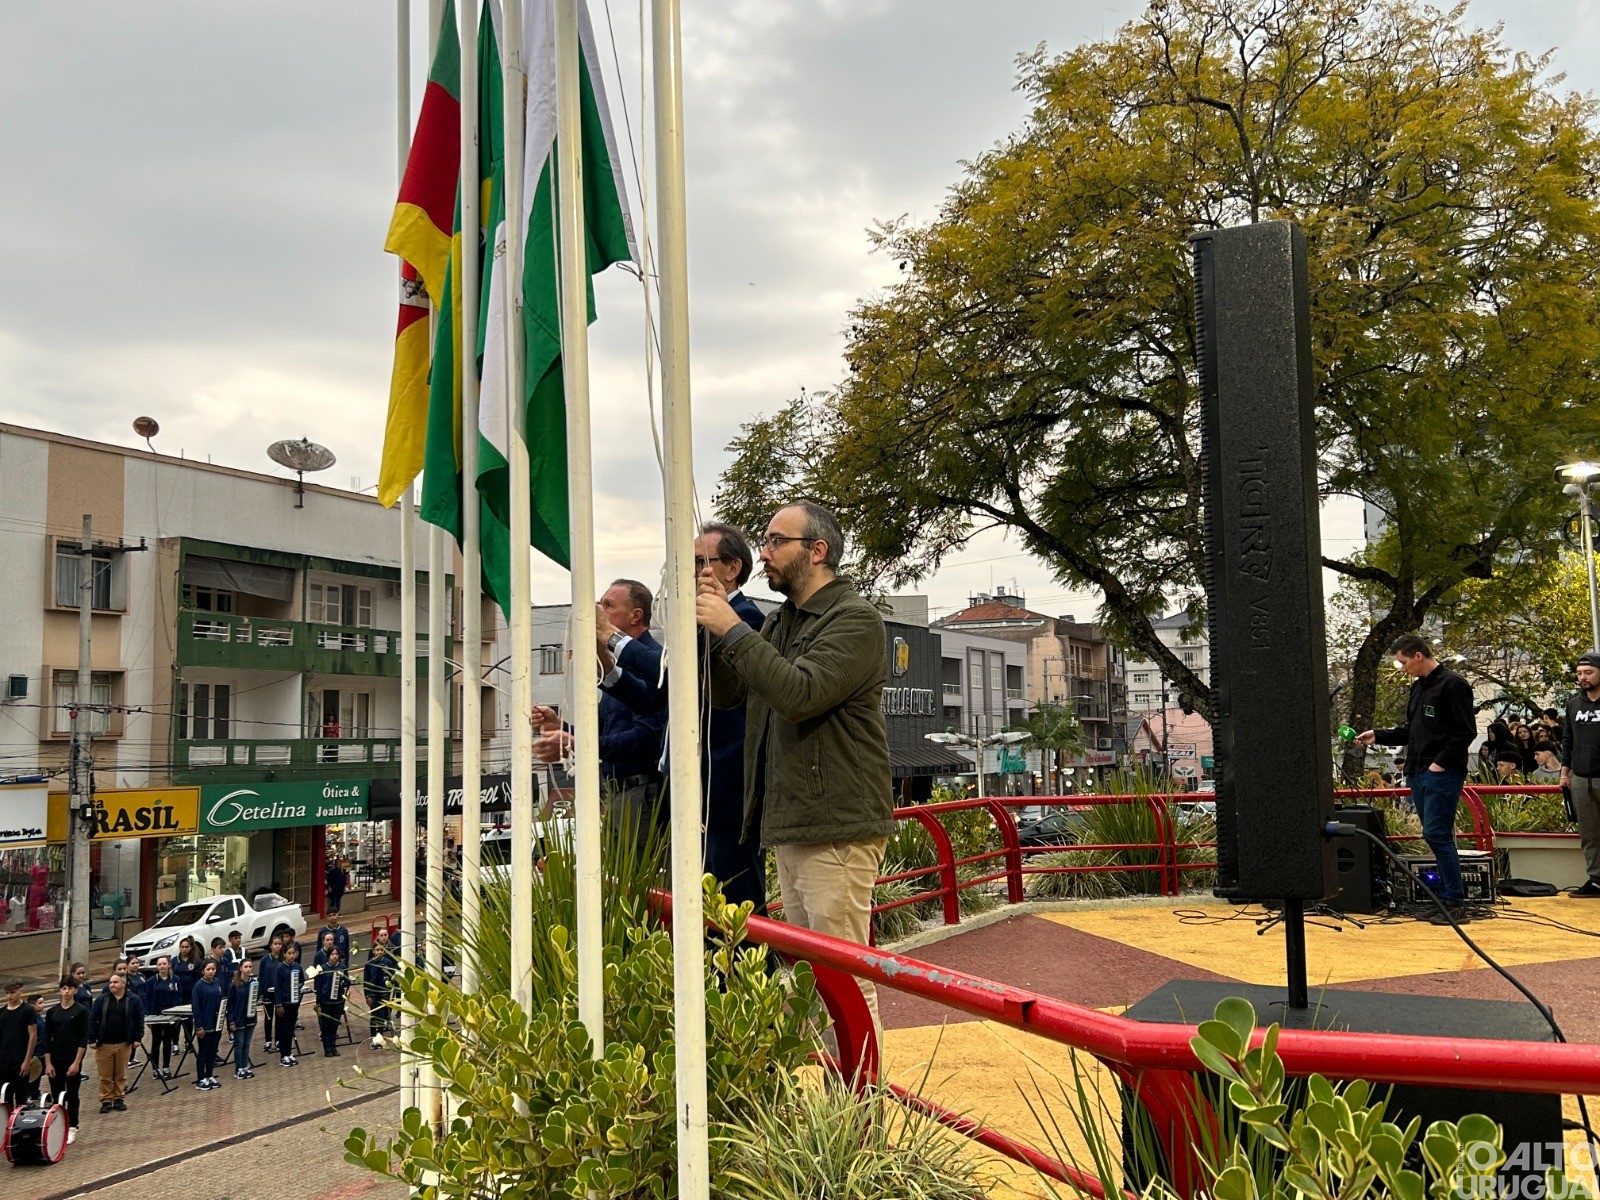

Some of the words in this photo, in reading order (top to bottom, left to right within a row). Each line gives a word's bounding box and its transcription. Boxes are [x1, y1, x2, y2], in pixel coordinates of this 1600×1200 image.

[322, 782, 349, 799] Ótica
[351, 785, 360, 797] &
[206, 789, 306, 827] Getelina
[315, 802, 363, 818] Joalheria
